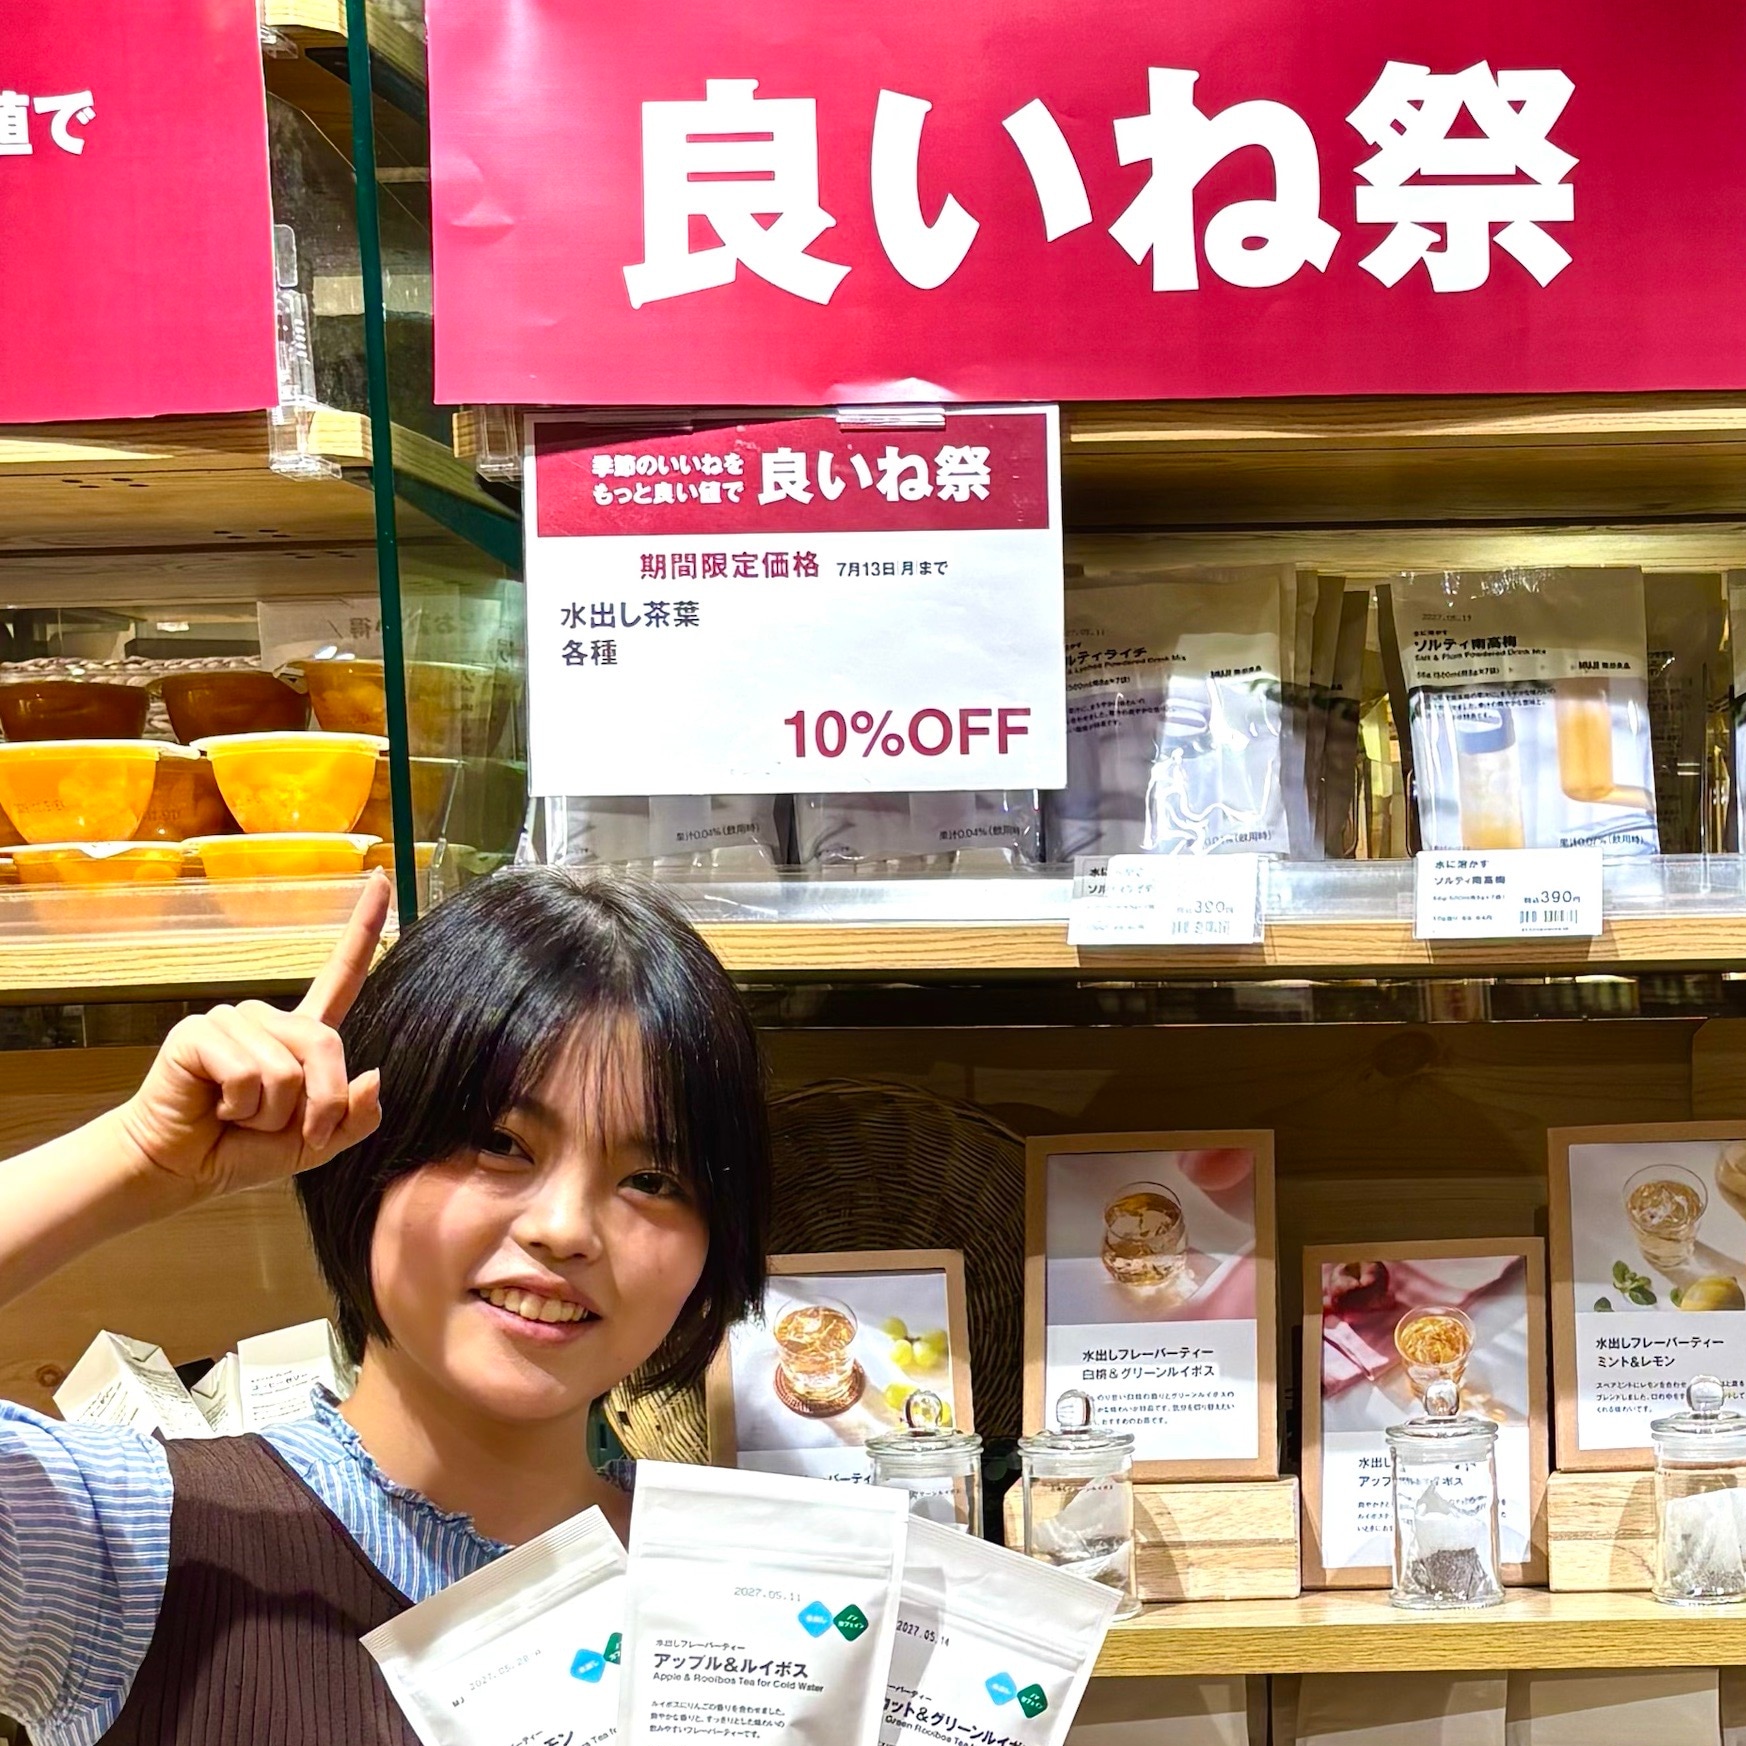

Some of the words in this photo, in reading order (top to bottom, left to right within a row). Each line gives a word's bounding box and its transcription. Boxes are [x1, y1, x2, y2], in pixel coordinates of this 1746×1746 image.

[622, 58, 1578, 308] 良いね祭
[591, 453, 744, 478] 季節のいいねを
[758, 445, 991, 506] 良いね祭
[593, 480, 745, 505] もっと良い値で
[640, 551, 820, 580] 期間限定価格
[560, 600, 700, 629] 水出し茶葉
[561, 639, 618, 667] 各種
[1414, 635, 1517, 651] ソルティ南高梅
[784, 708, 1031, 758] 10%OFF
[1082, 1346, 1214, 1362] 水出しフレーバーティー
[1596, 1337, 1724, 1350] 水出しフレーバーティー
[1082, 1365, 1215, 1381] 白桃&グリーンルイボス
[1598, 1356, 1675, 1368] ミント&レモン
[655, 1639, 746, 1651] 水出しフレーバーティー
[653, 1653, 809, 1678] アップル&ルイボス
[653, 1672, 682, 1683] Apple
[693, 1674, 736, 1685] Rooibos
[738, 1677, 755, 1686] Tea
[757, 1678, 771, 1687] for
[773, 1680, 796, 1690] Cold
[798, 1682, 824, 1692] Water
